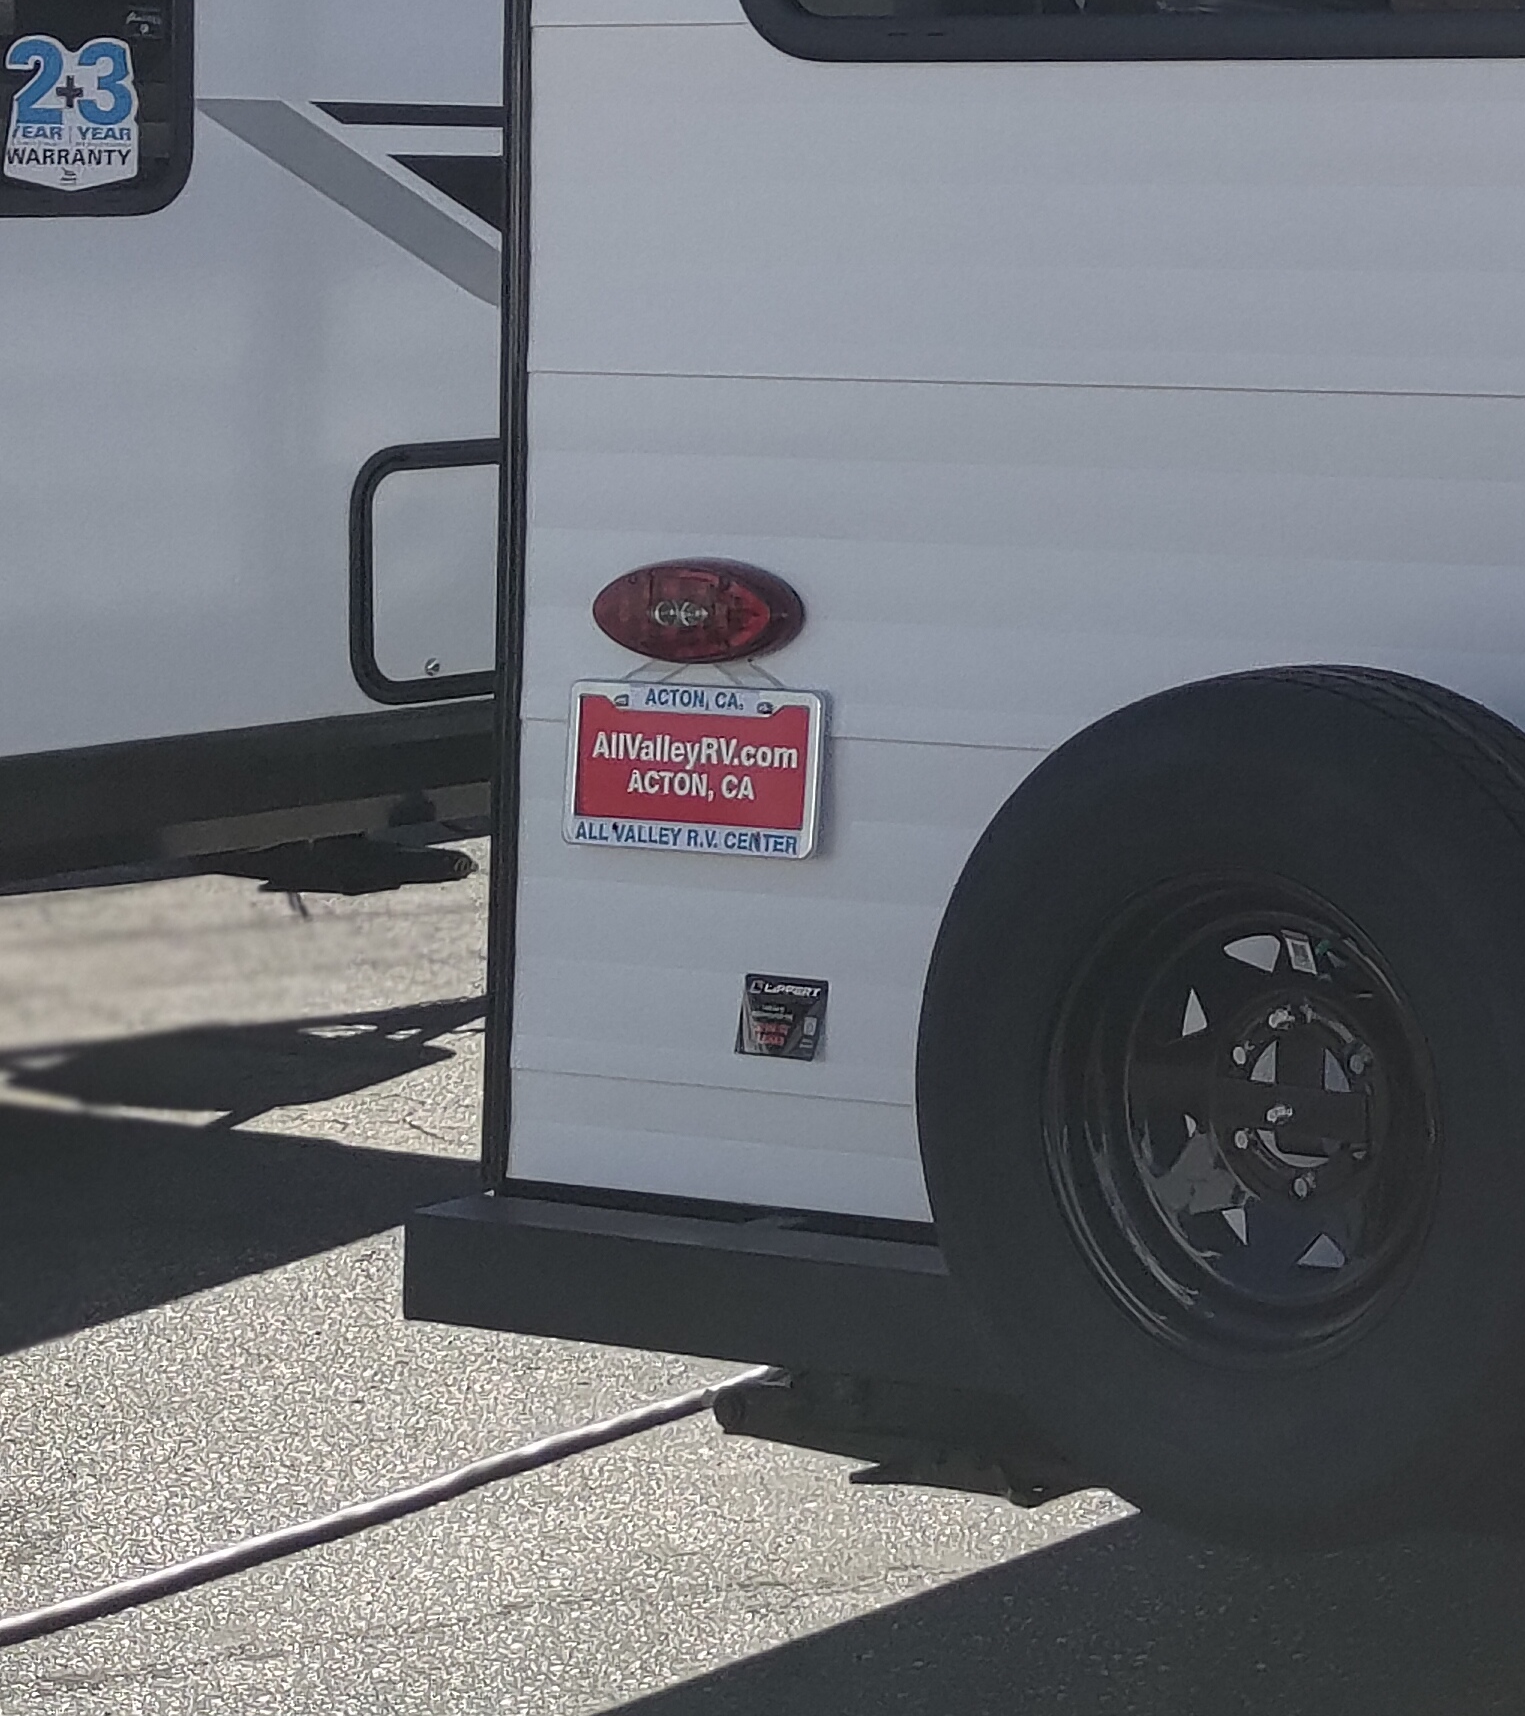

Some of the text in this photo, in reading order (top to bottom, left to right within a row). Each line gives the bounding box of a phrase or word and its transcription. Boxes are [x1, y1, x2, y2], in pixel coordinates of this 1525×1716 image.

[77, 126, 131, 141] YEAR
[7, 147, 132, 166] WARRANTY
[645, 688, 744, 711] ACTON, CA.
[592, 731, 798, 770] AllValleyRV.com
[627, 770, 755, 802] ACTON, CA
[575, 821, 798, 854] ALL VALLEY R.V. CENTER
